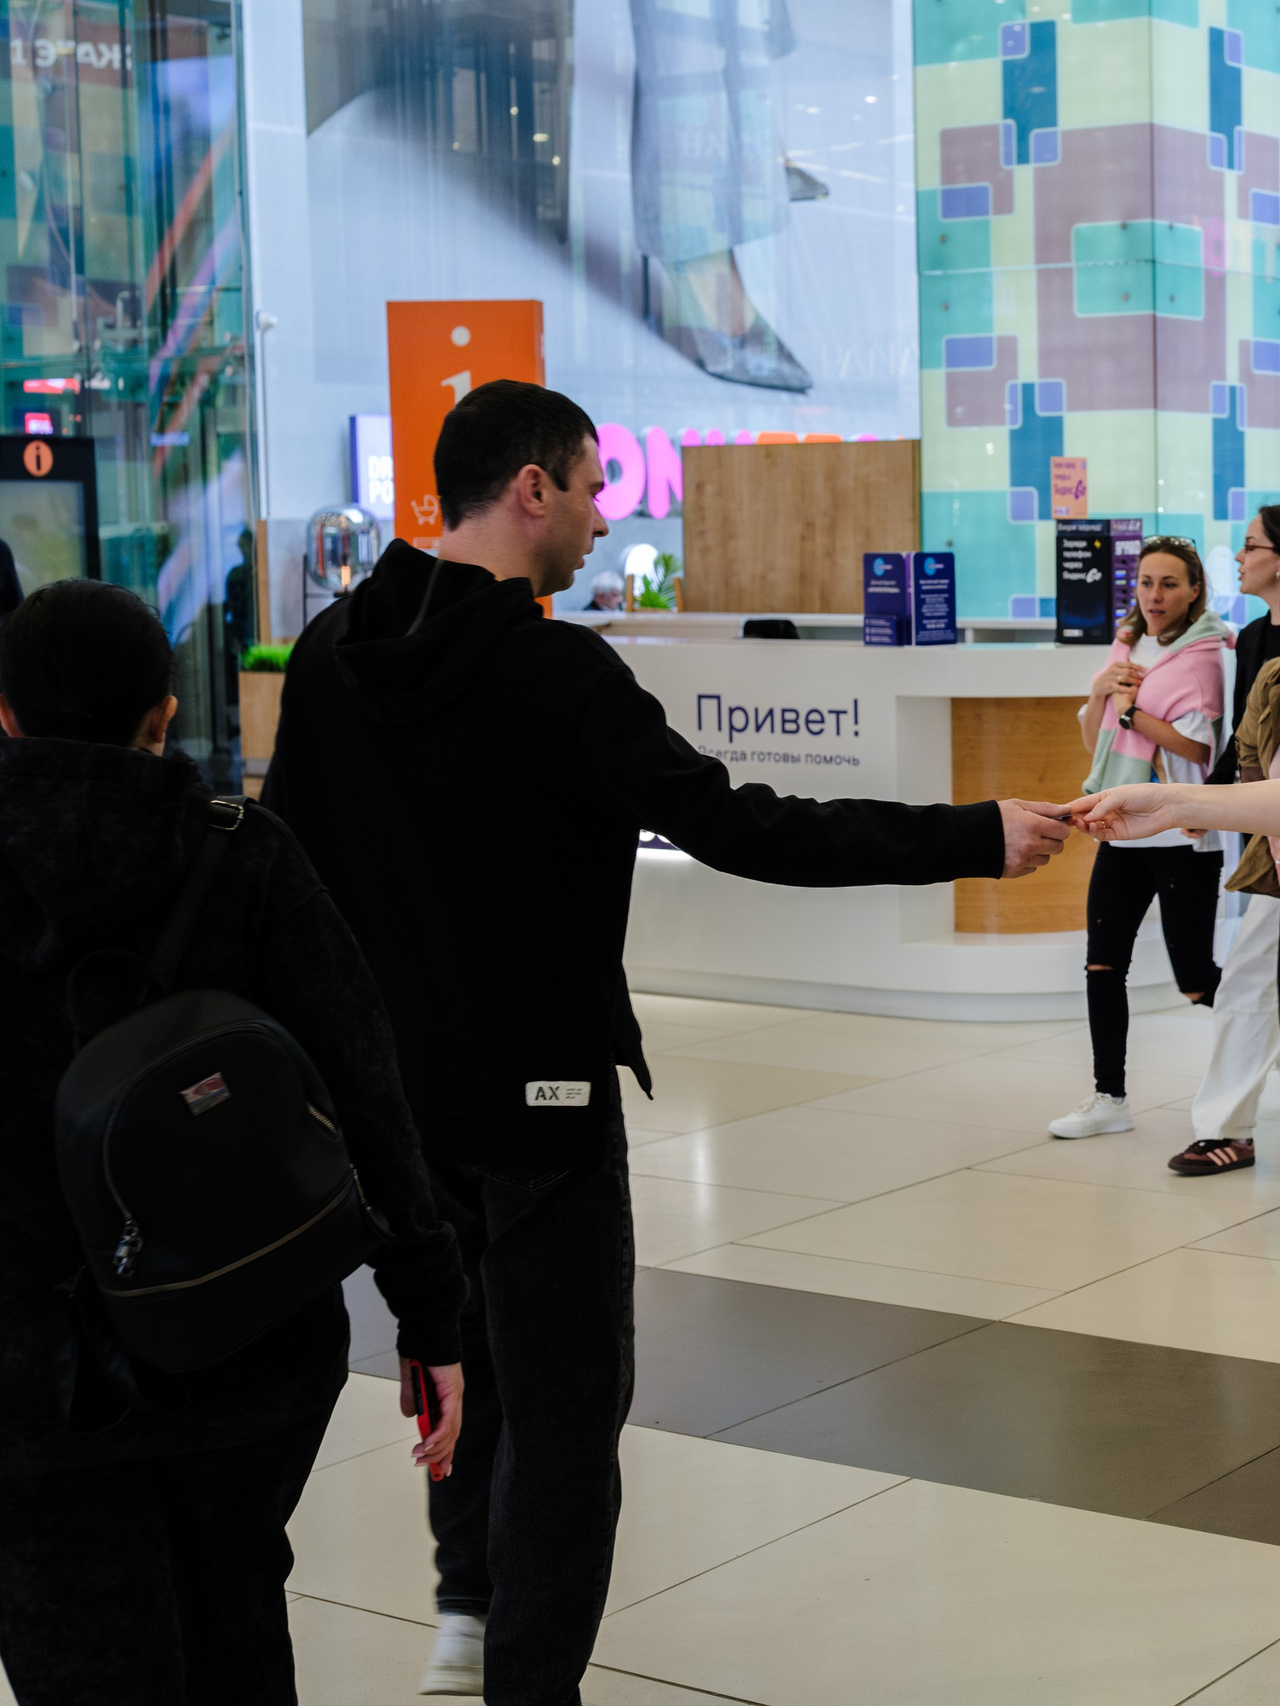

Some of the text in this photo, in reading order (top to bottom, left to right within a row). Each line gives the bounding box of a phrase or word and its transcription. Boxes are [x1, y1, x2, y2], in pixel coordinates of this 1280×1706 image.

[697, 694, 859, 743] Привет!
[750, 750, 800, 764] готовы
[804, 752, 861, 767] помочь
[534, 1086, 561, 1101] AX
